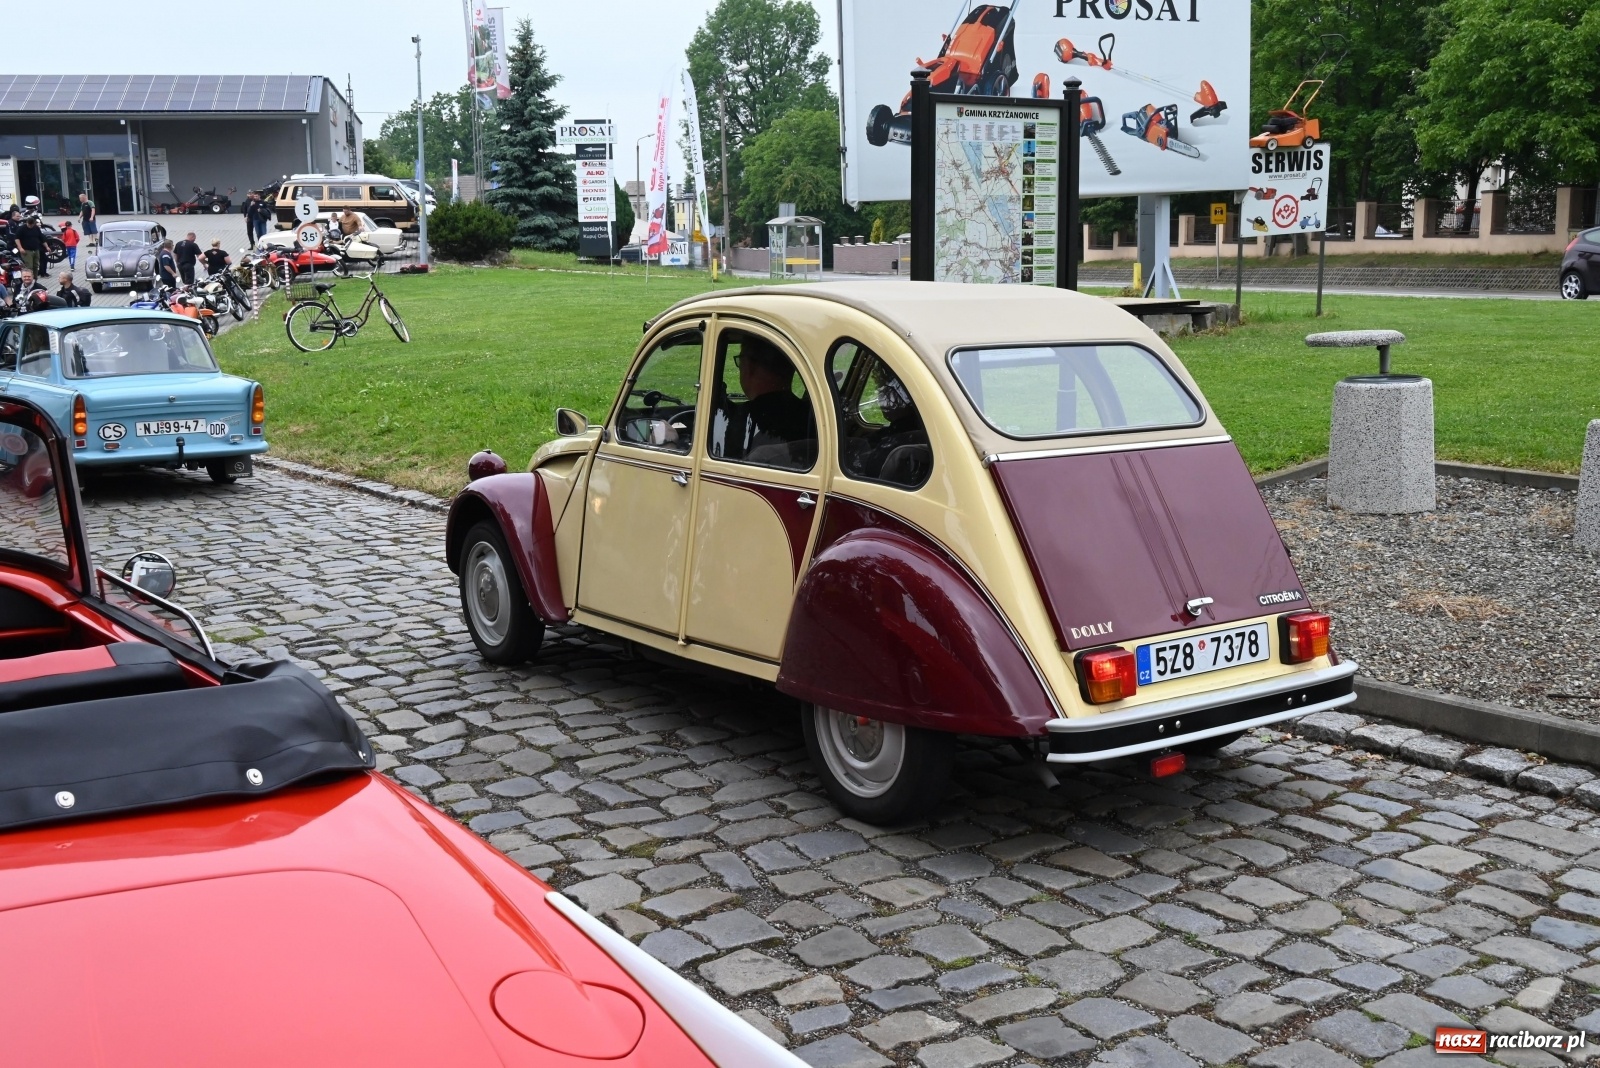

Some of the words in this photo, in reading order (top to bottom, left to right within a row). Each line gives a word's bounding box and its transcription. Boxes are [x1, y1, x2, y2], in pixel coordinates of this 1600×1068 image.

[1053, 0, 1200, 22] PROSAT
[488, 16, 498, 60] FERRIS
[964, 109, 987, 118] GMINA
[988, 110, 1040, 120] KRZYŻANOWICE
[560, 126, 614, 136] PROSAT
[1251, 149, 1324, 174] SERWIS
[1268, 172, 1307, 180] www.prosat.pl
[303, 204, 310, 215] 5
[663, 243, 687, 255] ROSAT
[102, 425, 123, 438] CS
[210, 423, 226, 436] DDR
[1259, 591, 1296, 605] CITROËN
[1070, 621, 1114, 640] DOLLY
[1155, 642, 1195, 676] 5Z8
[1210, 629, 1260, 667] 7378
[1140, 671, 1150, 680] CZ
